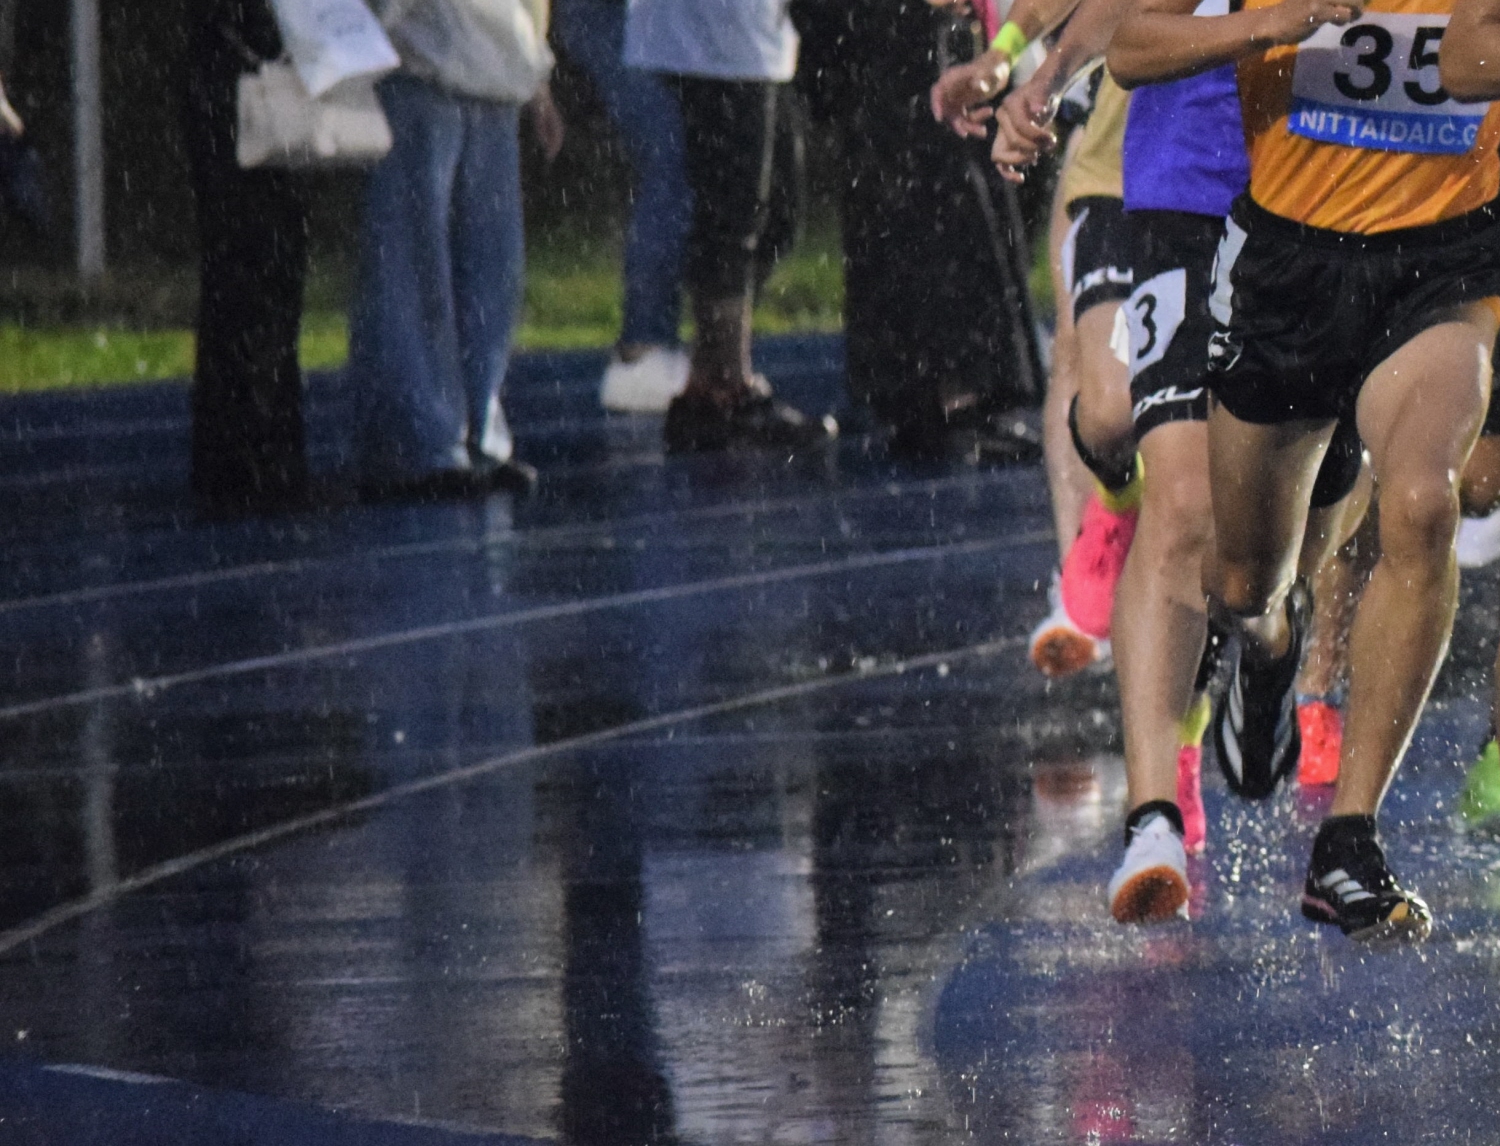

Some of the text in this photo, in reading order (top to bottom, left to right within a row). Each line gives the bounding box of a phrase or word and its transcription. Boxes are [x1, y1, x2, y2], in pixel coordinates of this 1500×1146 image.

[1333, 24, 1450, 106] 35
[1301, 108, 1434, 144] NITTAIDAI
[1135, 293, 1157, 360] 3
